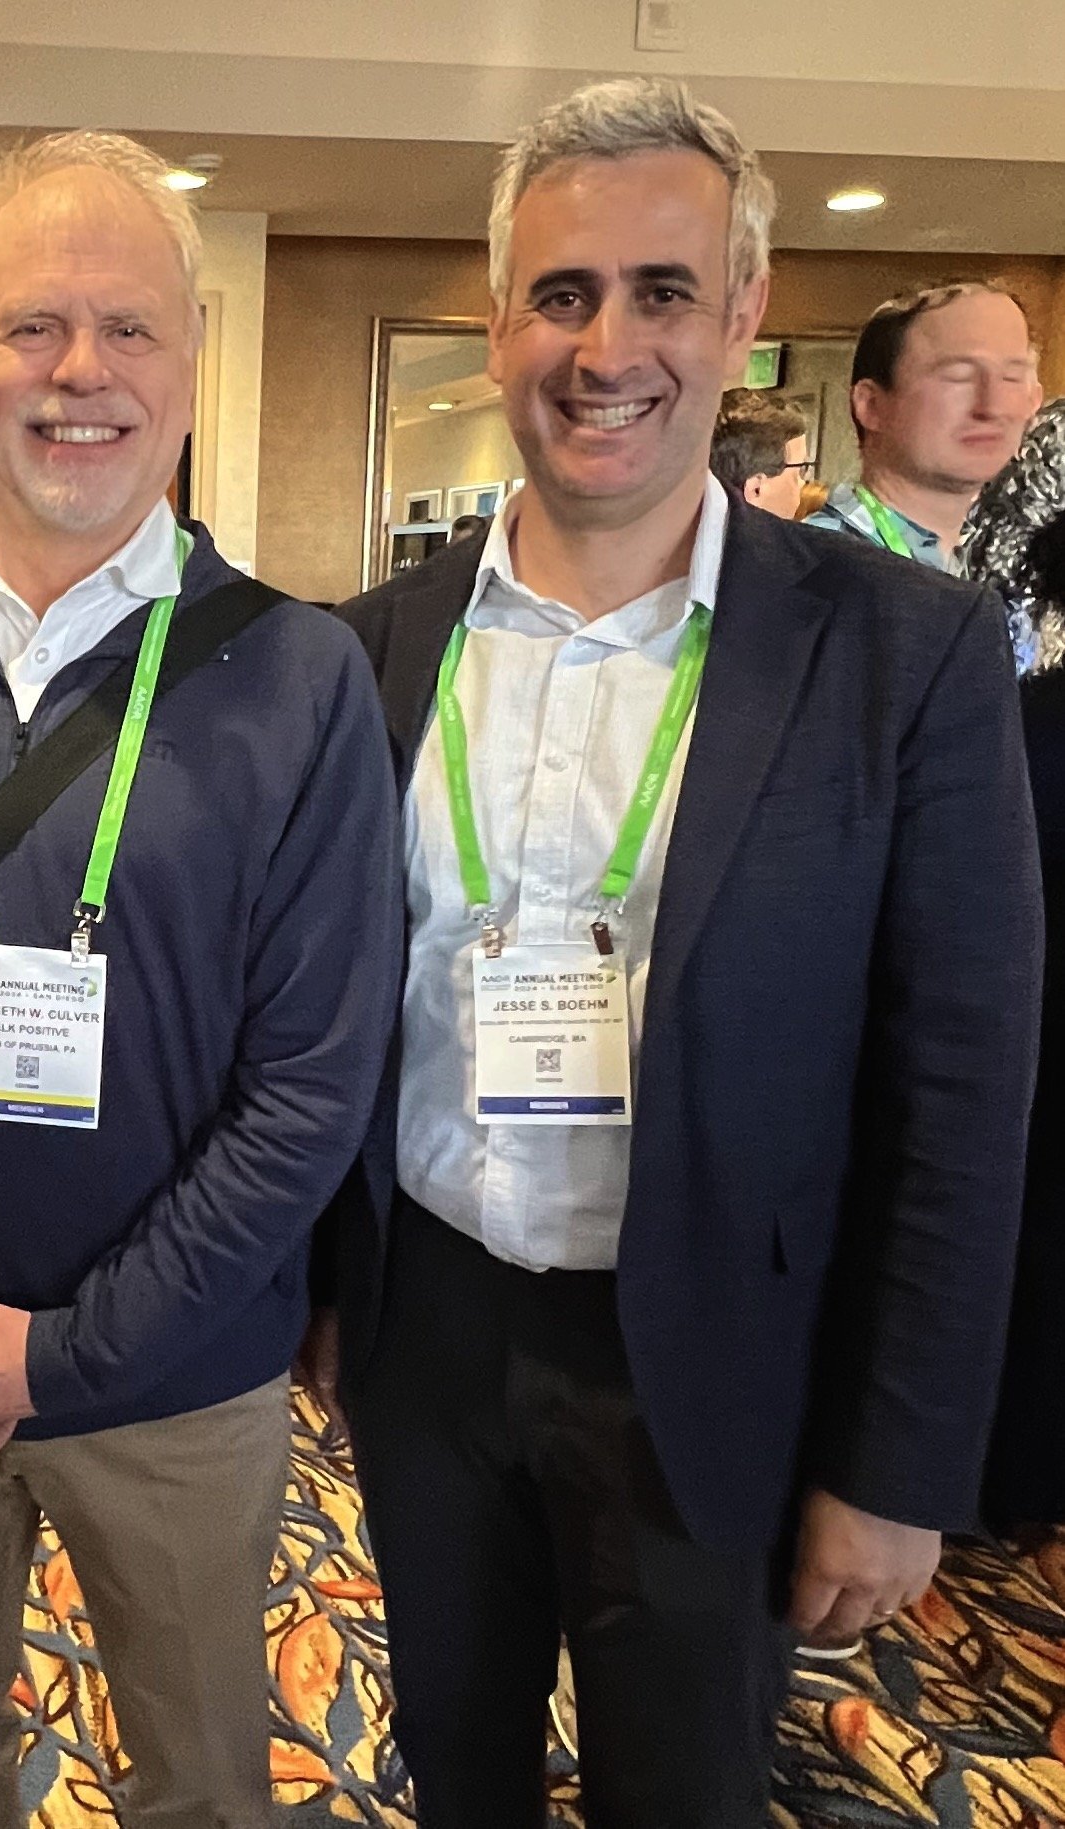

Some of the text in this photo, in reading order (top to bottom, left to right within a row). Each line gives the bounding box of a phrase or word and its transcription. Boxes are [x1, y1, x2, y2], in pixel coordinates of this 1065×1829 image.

[515, 973, 603, 984] ANNUAL MEETING
[0, 980, 40, 992] ANNUAL
[43, 982, 85, 995] MEETING
[493, 999, 609, 1012] JESSE S. BOEHM
[29, 1008, 44, 1019] W.
[48, 1010, 100, 1023] CULVER
[19, 1024, 70, 1037] POSITIVE
[4, 1040, 17, 1048] OF
[63, 1045, 76, 1053] PA
